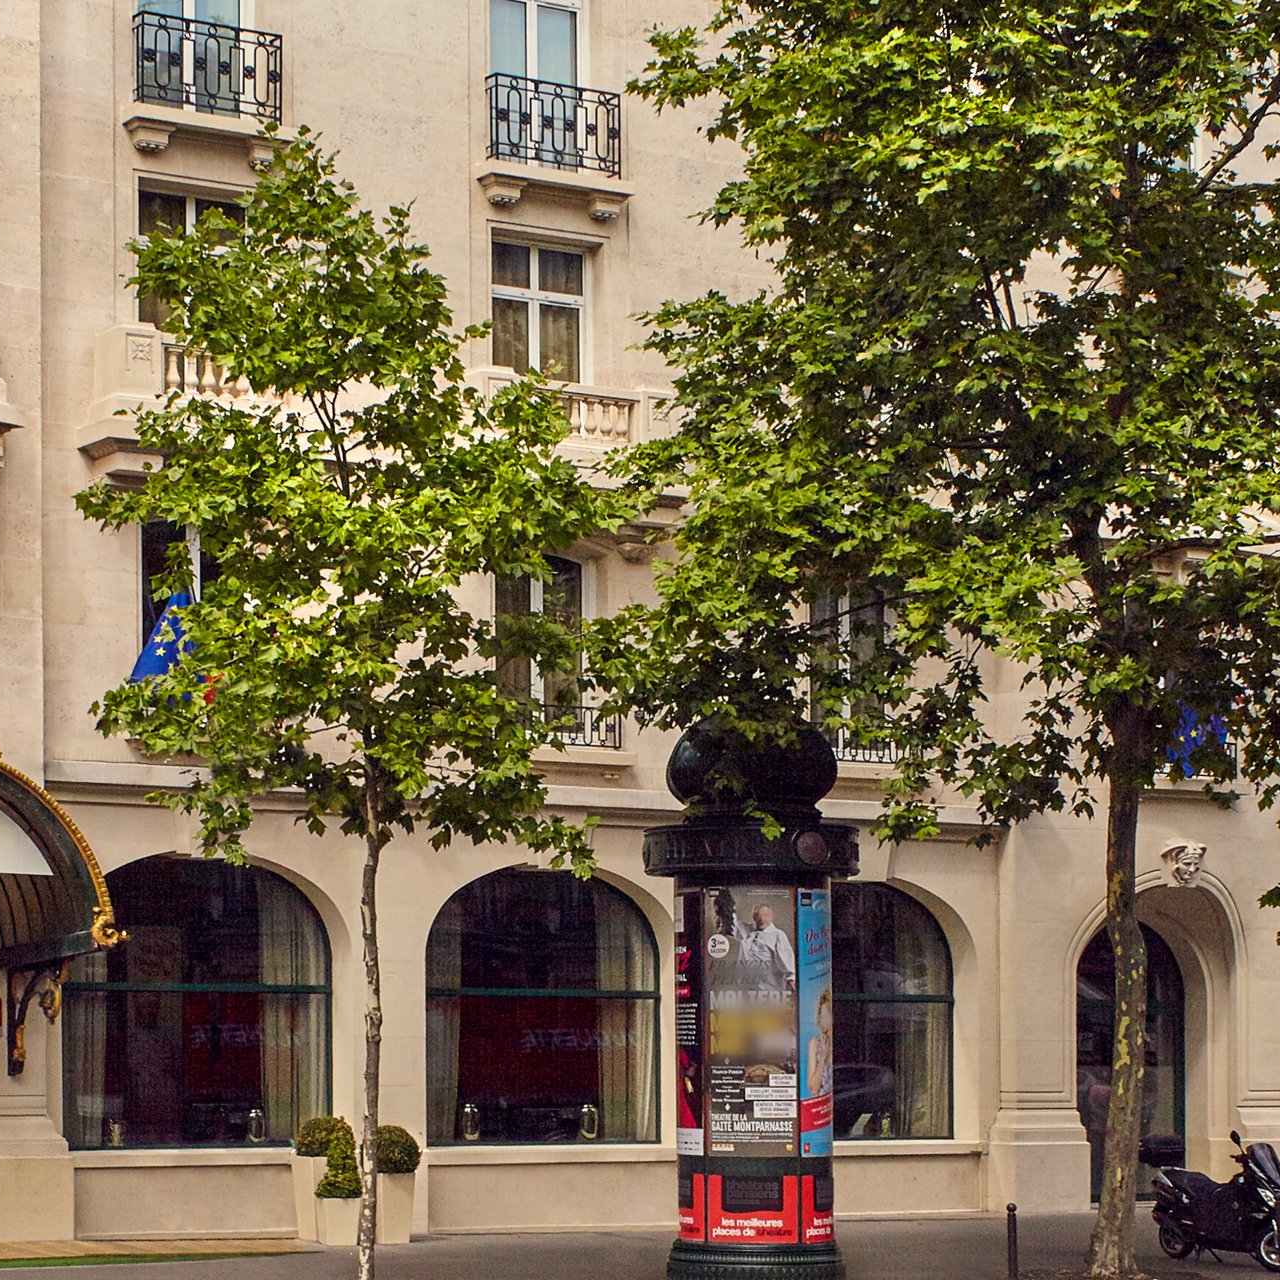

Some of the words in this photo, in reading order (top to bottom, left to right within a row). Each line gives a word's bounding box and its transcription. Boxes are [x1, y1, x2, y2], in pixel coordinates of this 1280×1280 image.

[709, 959, 769, 971] FRANCIS
[711, 974, 769, 985] PERRIN
[732, 1113, 739, 1121] DE
[740, 1113, 748, 1121] LA
[733, 1121, 793, 1131] MONTPARNASSE
[726, 1190, 779, 1201] parisiens
[722, 1217, 735, 1227] les
[736, 1217, 783, 1227] meilleures
[813, 1217, 823, 1226] les
[712, 1226, 741, 1238] places
[742, 1227, 755, 1236] de
[806, 1227, 825, 1238] places
